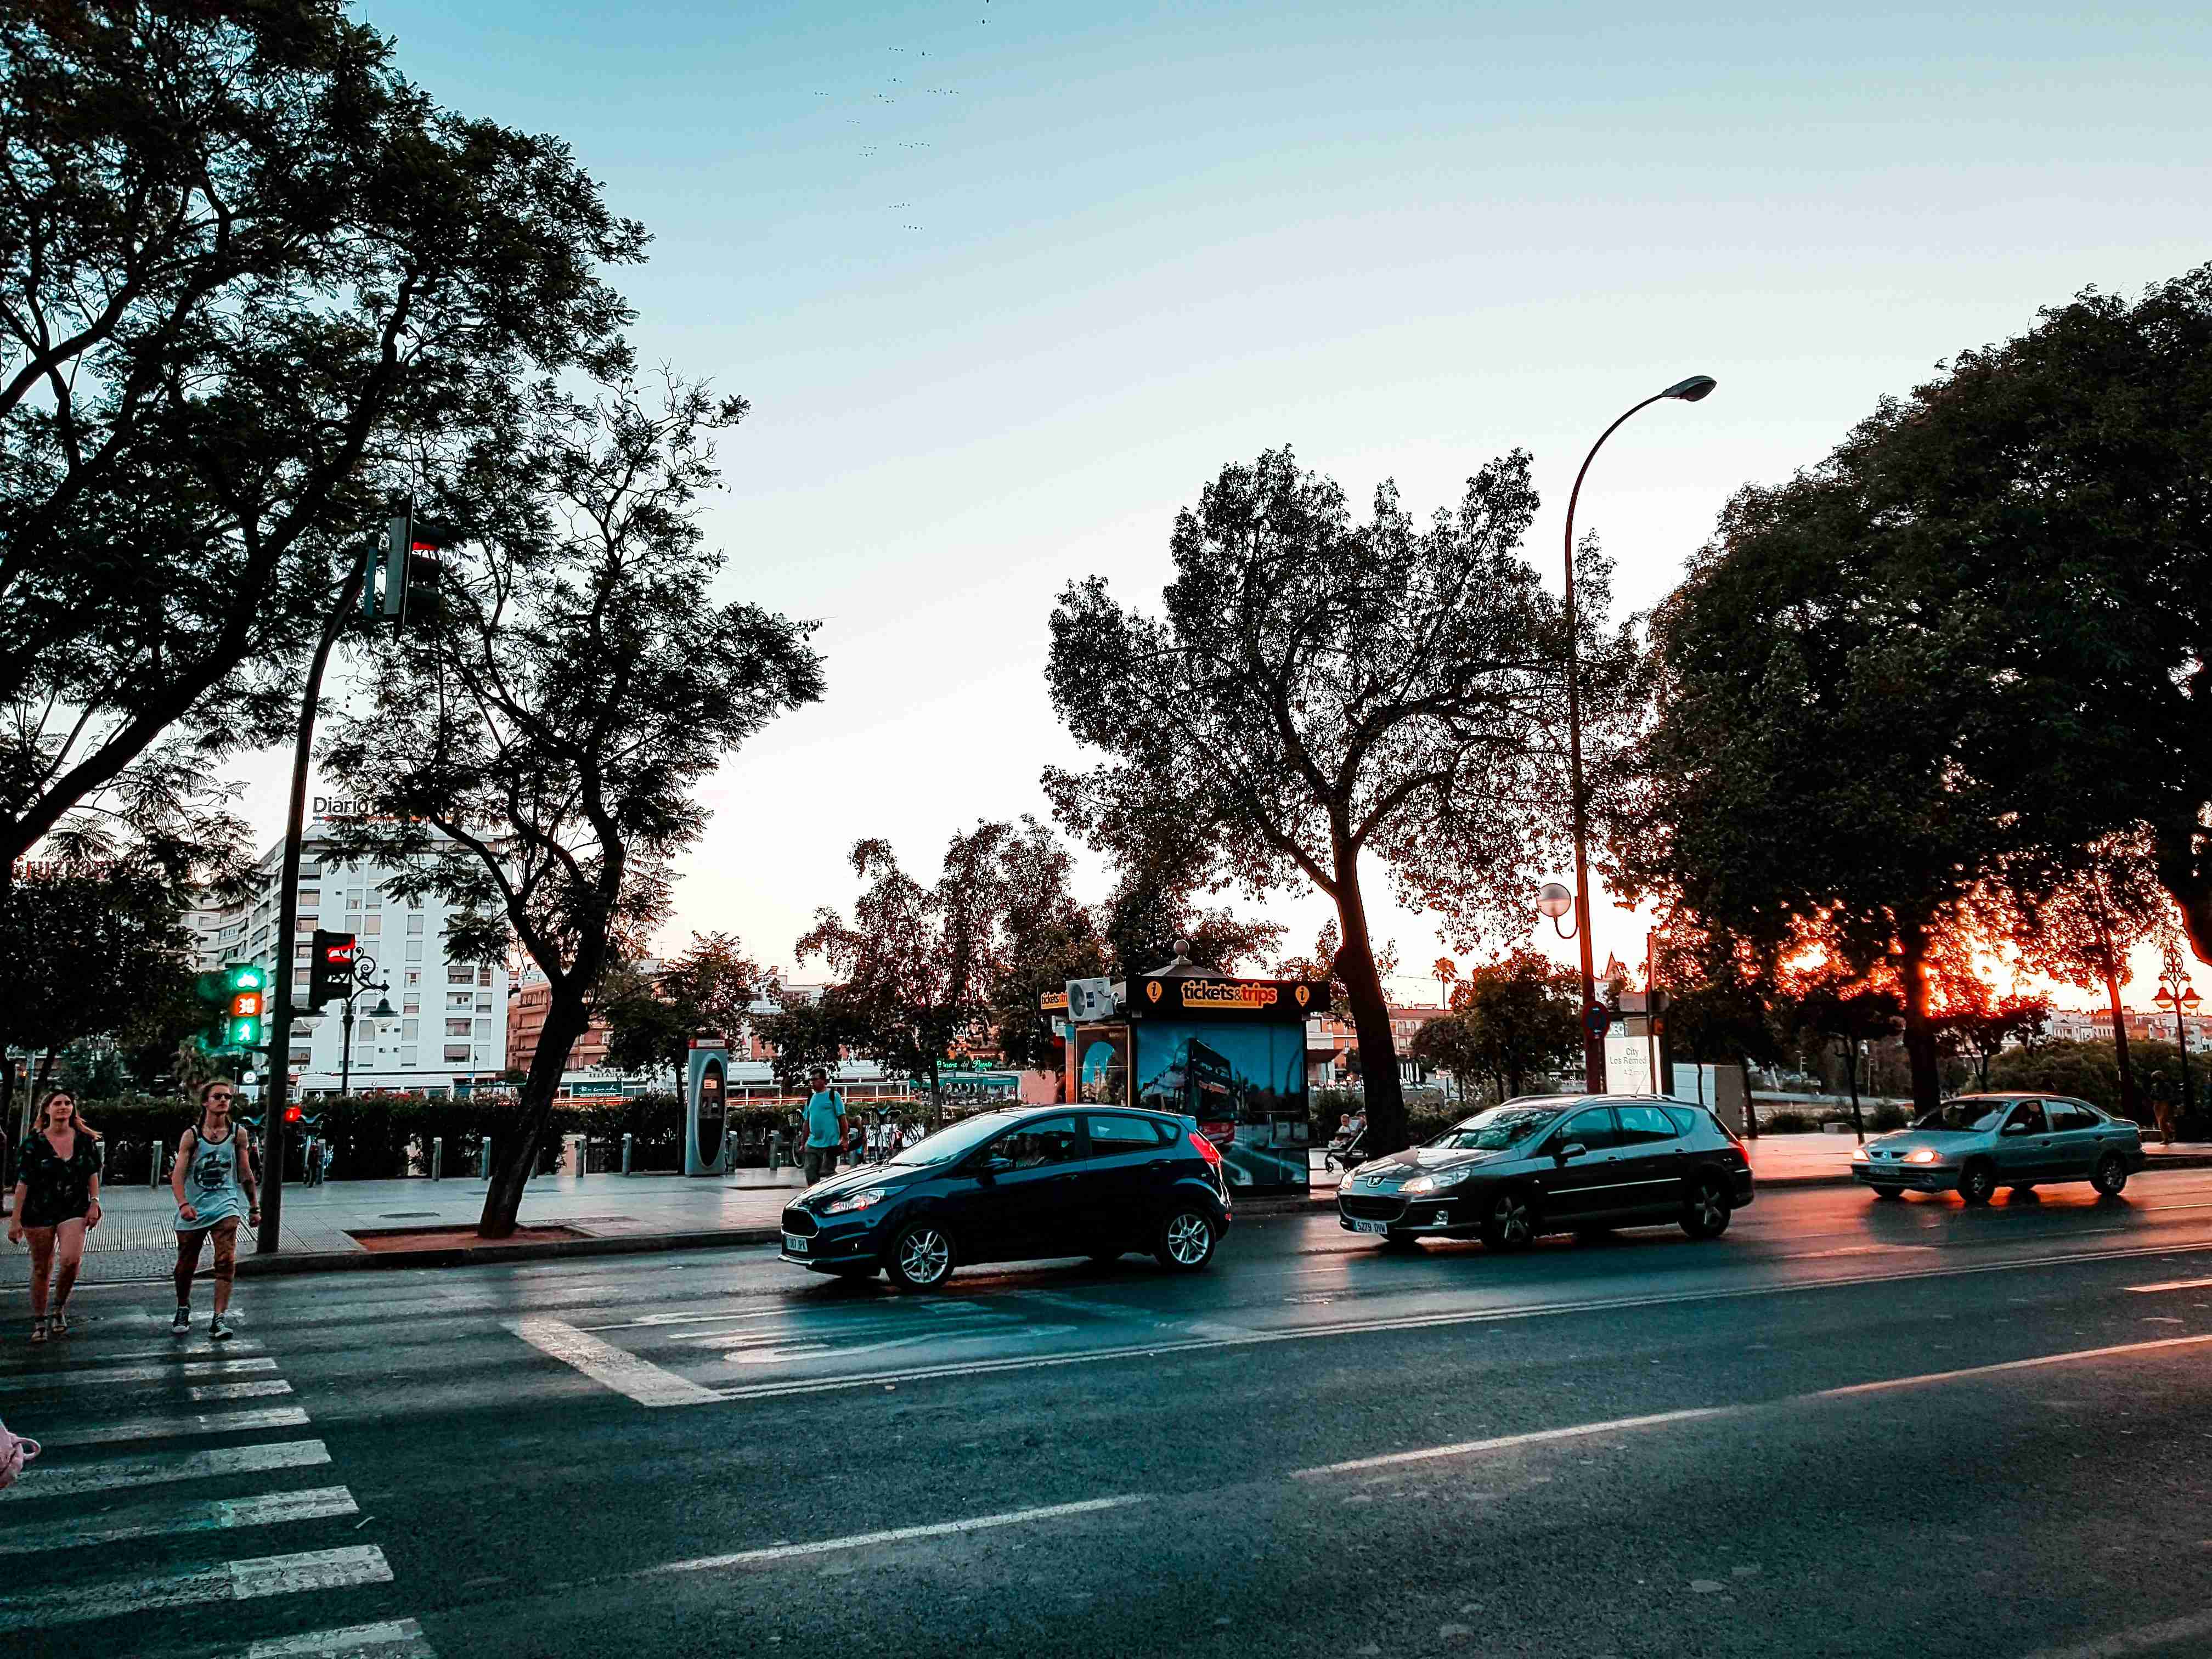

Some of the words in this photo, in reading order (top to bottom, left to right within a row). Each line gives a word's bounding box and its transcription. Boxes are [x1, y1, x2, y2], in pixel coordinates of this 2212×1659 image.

[313, 797, 369, 813] Diario
[1042, 992, 1067, 1005] tickets&tri
[1184, 981, 1276, 1006] tickets&trips
[1626, 1047, 1639, 1057] City
